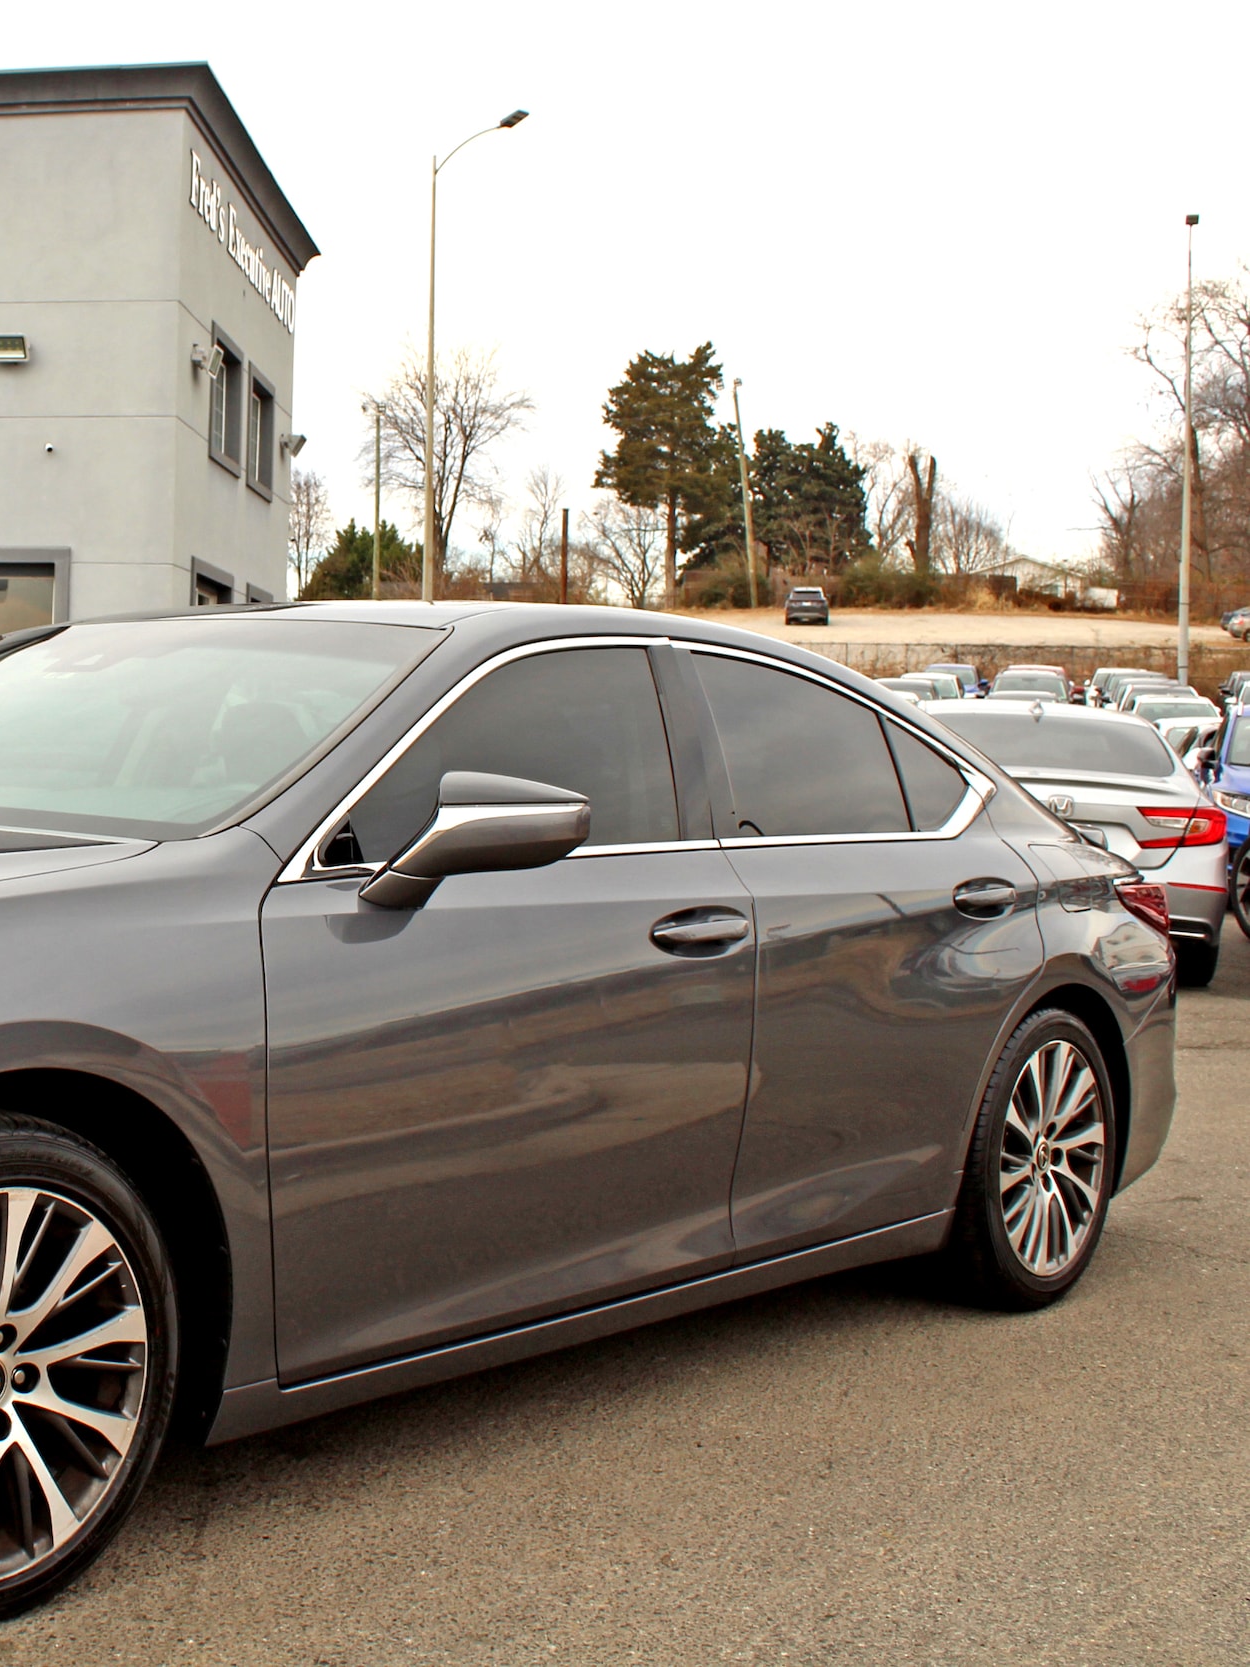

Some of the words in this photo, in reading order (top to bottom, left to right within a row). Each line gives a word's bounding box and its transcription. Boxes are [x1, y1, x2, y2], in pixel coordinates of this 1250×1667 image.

[190, 148, 225, 243] Fred's
[227, 202, 271, 303] Executive
[270, 268, 295, 334] AUTO
